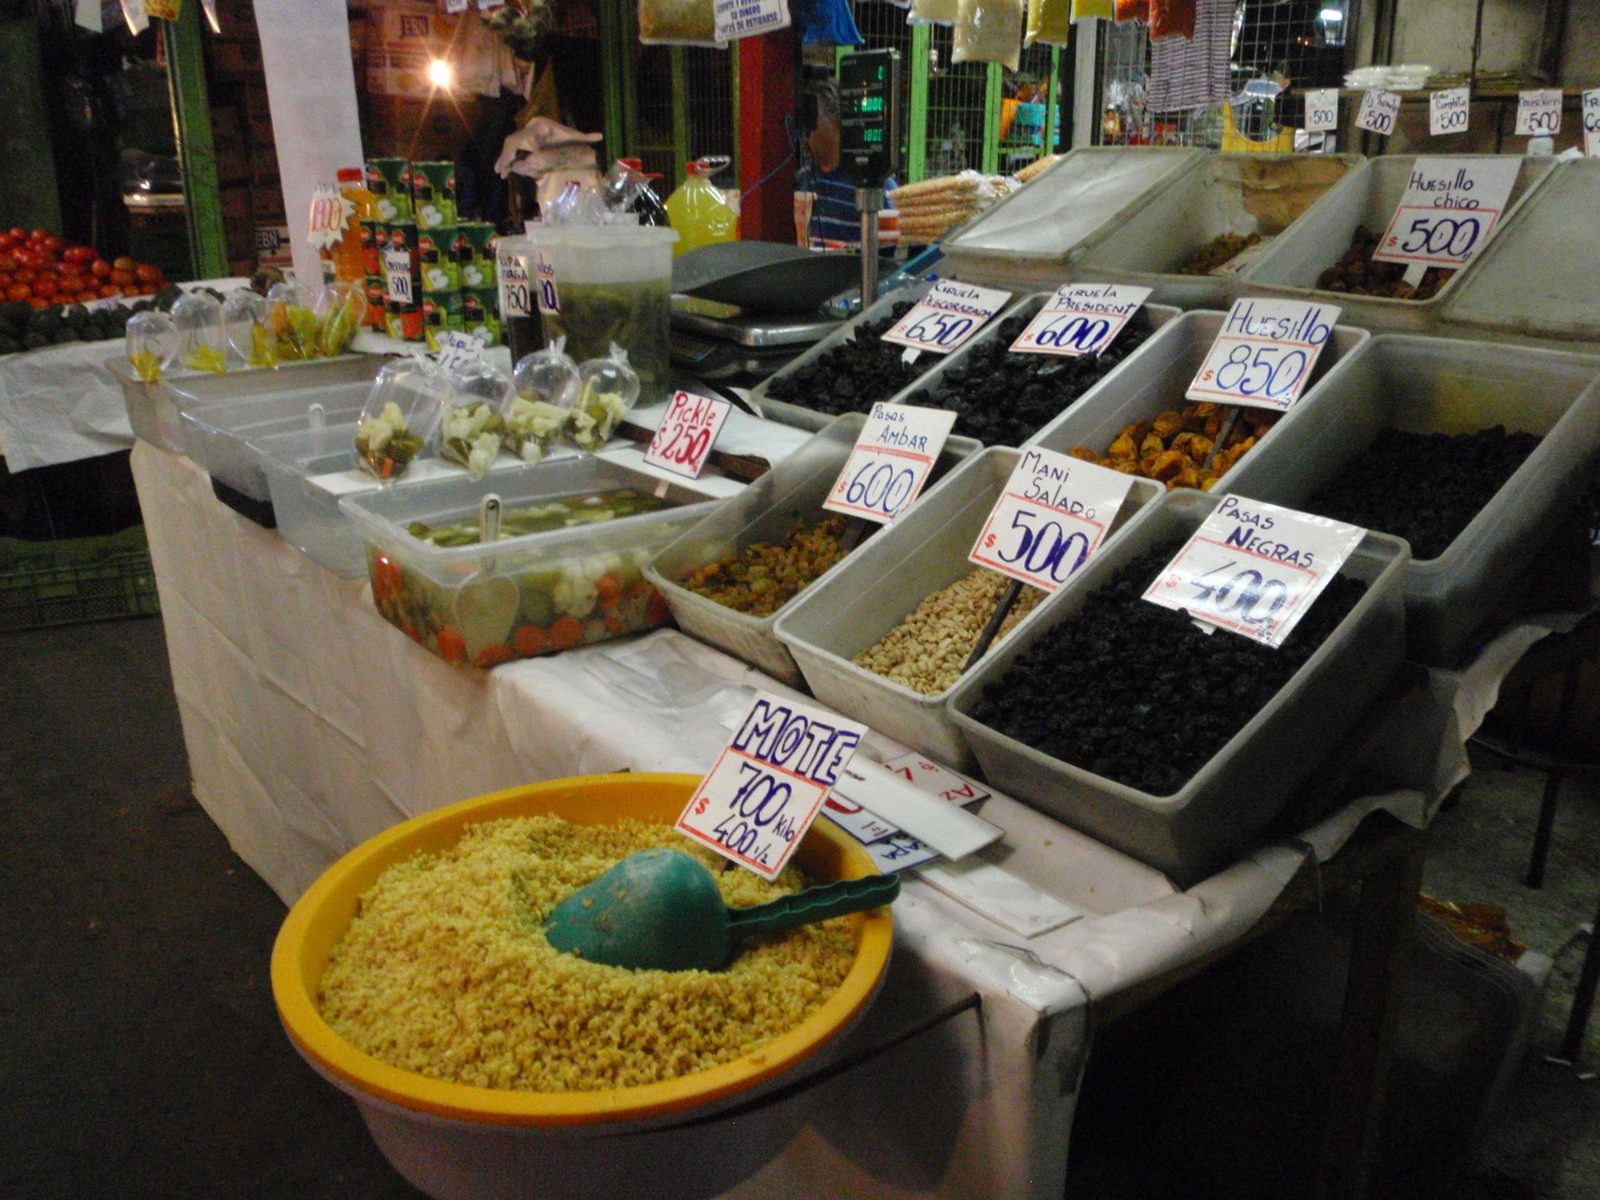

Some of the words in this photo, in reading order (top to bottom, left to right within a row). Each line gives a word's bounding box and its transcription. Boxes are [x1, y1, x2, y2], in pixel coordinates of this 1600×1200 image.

[1433, 192, 1480, 210] chico
[1055, 297, 1137, 315] PRESIDENT
[669, 392, 716, 426] Pickle
[872, 404, 905, 421] Pasas
[876, 425, 928, 453] AMbAR
[1021, 451, 1071, 482] MANi
[1024, 477, 1097, 520] SAlADO
[1217, 497, 1275, 530] PASAS
[1225, 526, 1315, 569] NEGRAS
[731, 699, 861, 786] MOTE
[713, 814, 758, 855] 400
